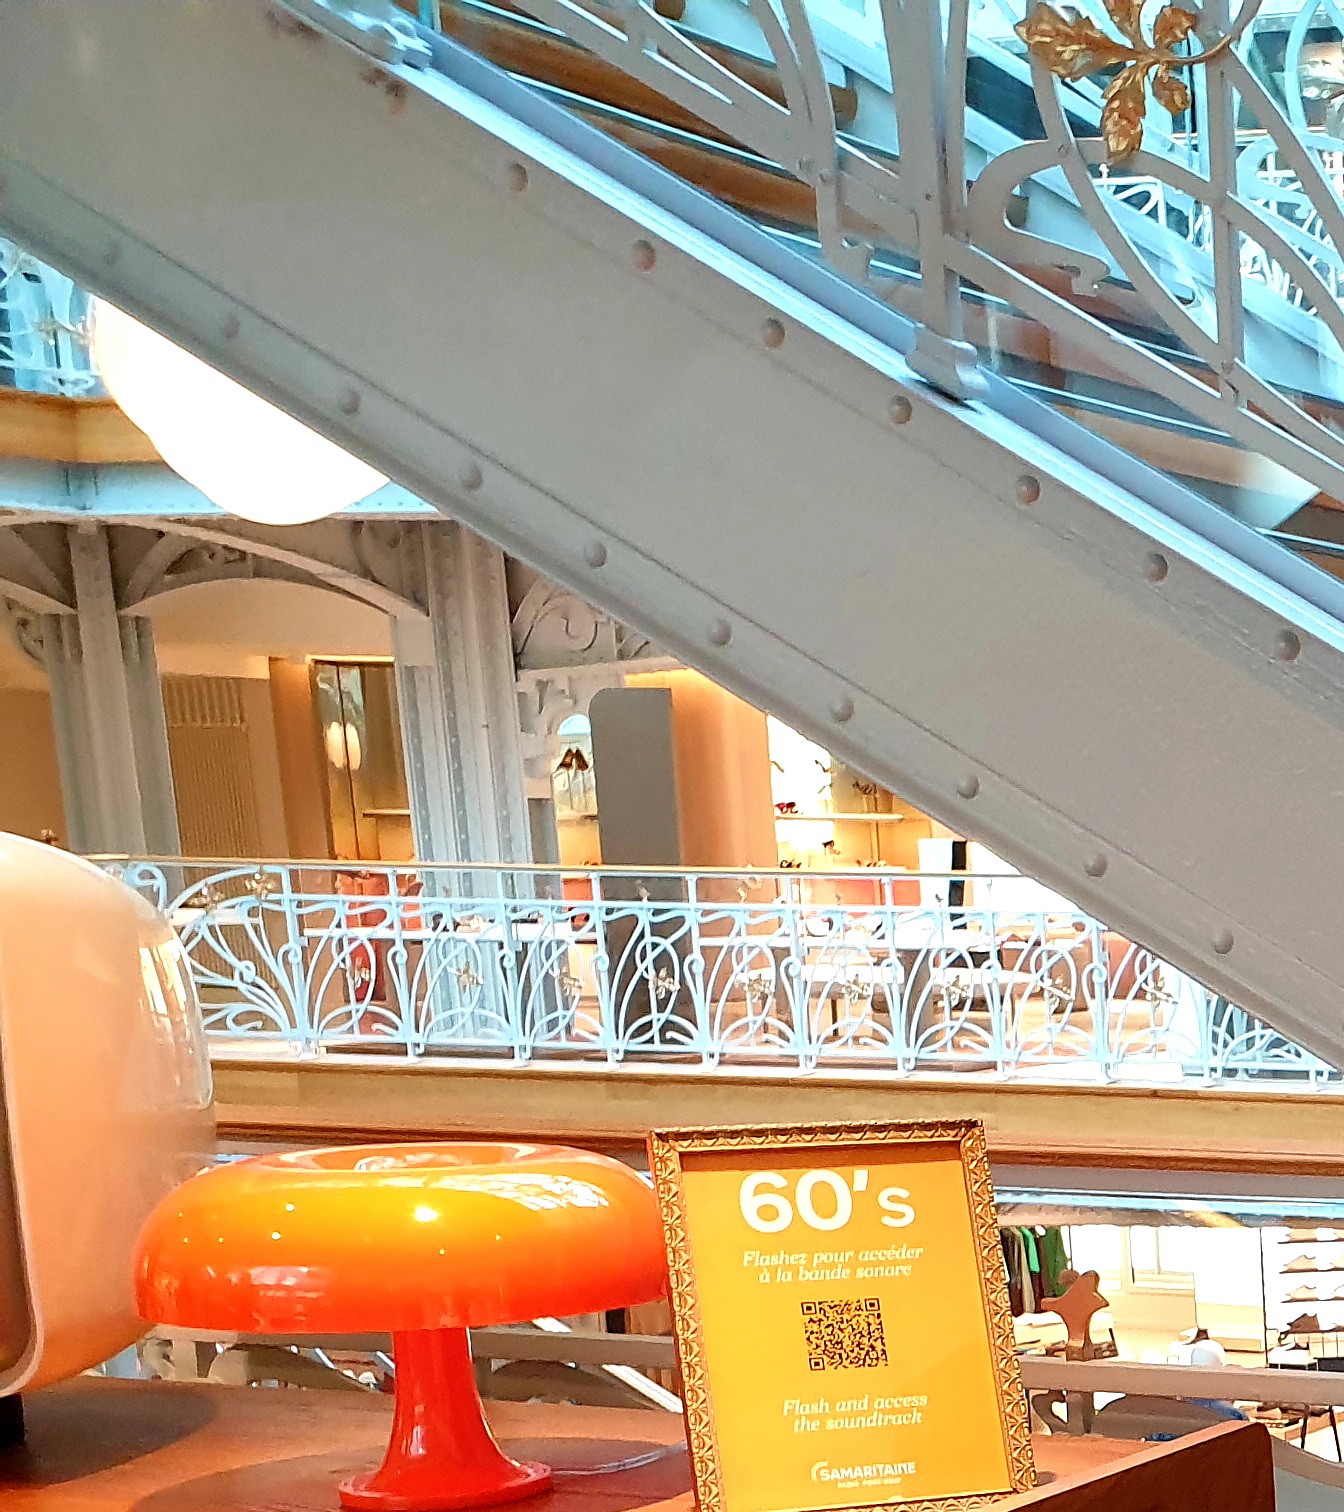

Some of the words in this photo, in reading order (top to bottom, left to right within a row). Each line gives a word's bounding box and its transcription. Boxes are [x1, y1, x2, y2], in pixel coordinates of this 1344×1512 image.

[739, 1169, 916, 1233] 60's
[743, 1249, 809, 1268] Flashez
[812, 1249, 855, 1267] pour
[858, 1243, 925, 1262] accéder
[758, 1267, 771, 1283] à
[776, 1266, 794, 1283] la
[797, 1264, 851, 1281] bande
[855, 1264, 913, 1279] sonore
[783, 1397, 831, 1417] Flash
[835, 1393, 870, 1412] and
[873, 1394, 929, 1411] access
[793, 1414, 821, 1433] the
[825, 1407, 923, 1431] soundtrack
[817, 1461, 917, 1482] SAMARITAINE
